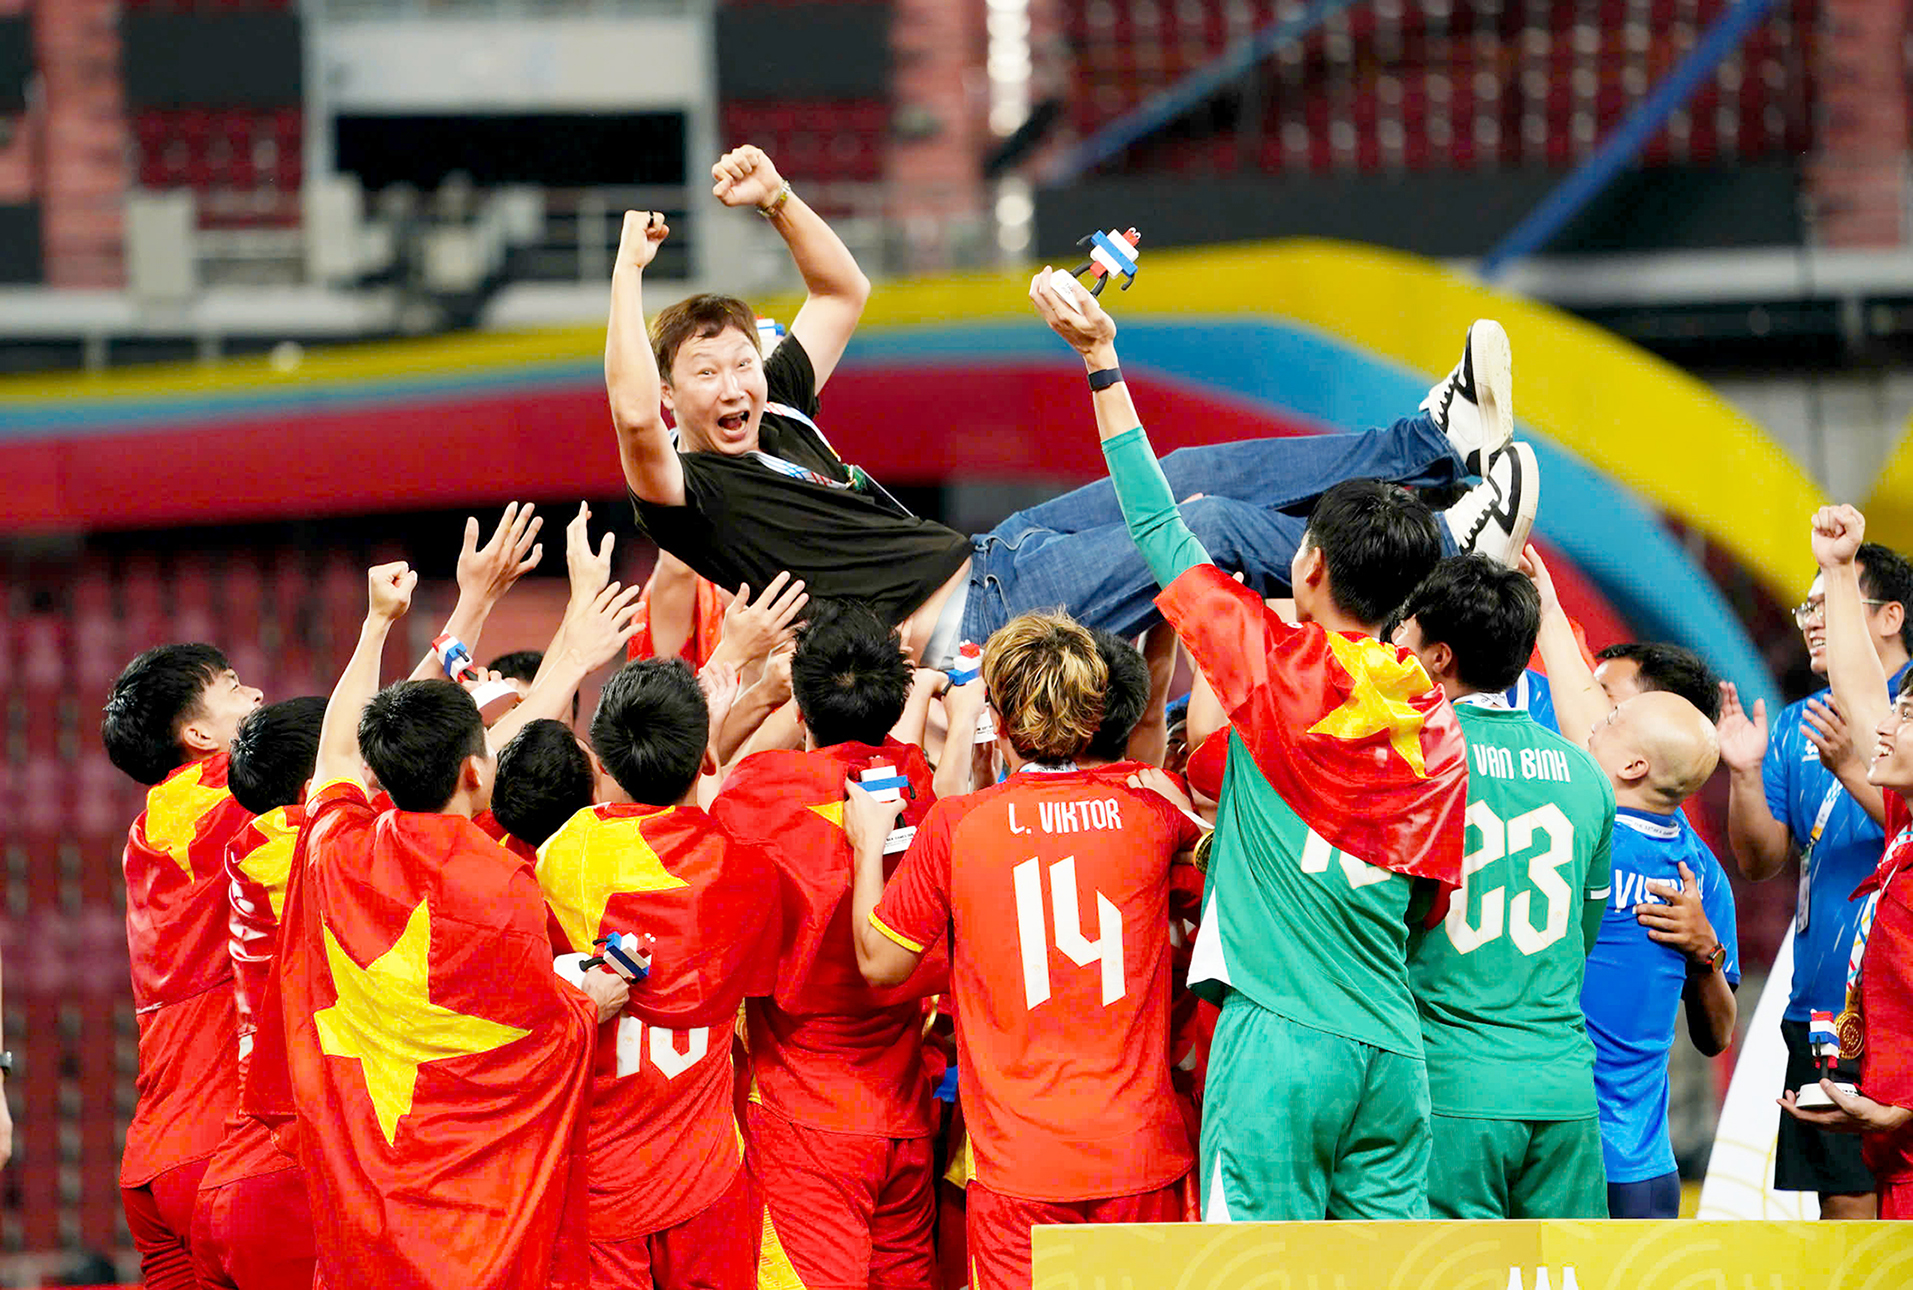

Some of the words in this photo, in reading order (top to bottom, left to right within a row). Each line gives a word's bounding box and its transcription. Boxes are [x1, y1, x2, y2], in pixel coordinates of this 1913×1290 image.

[1472, 744, 1515, 780] VAN
[1519, 748, 1571, 782] BINH
[1008, 802, 1032, 834] L.
[1038, 798, 1122, 834] VIKTOR
[1445, 799, 1575, 956] 23
[1013, 855, 1126, 1011] 14
